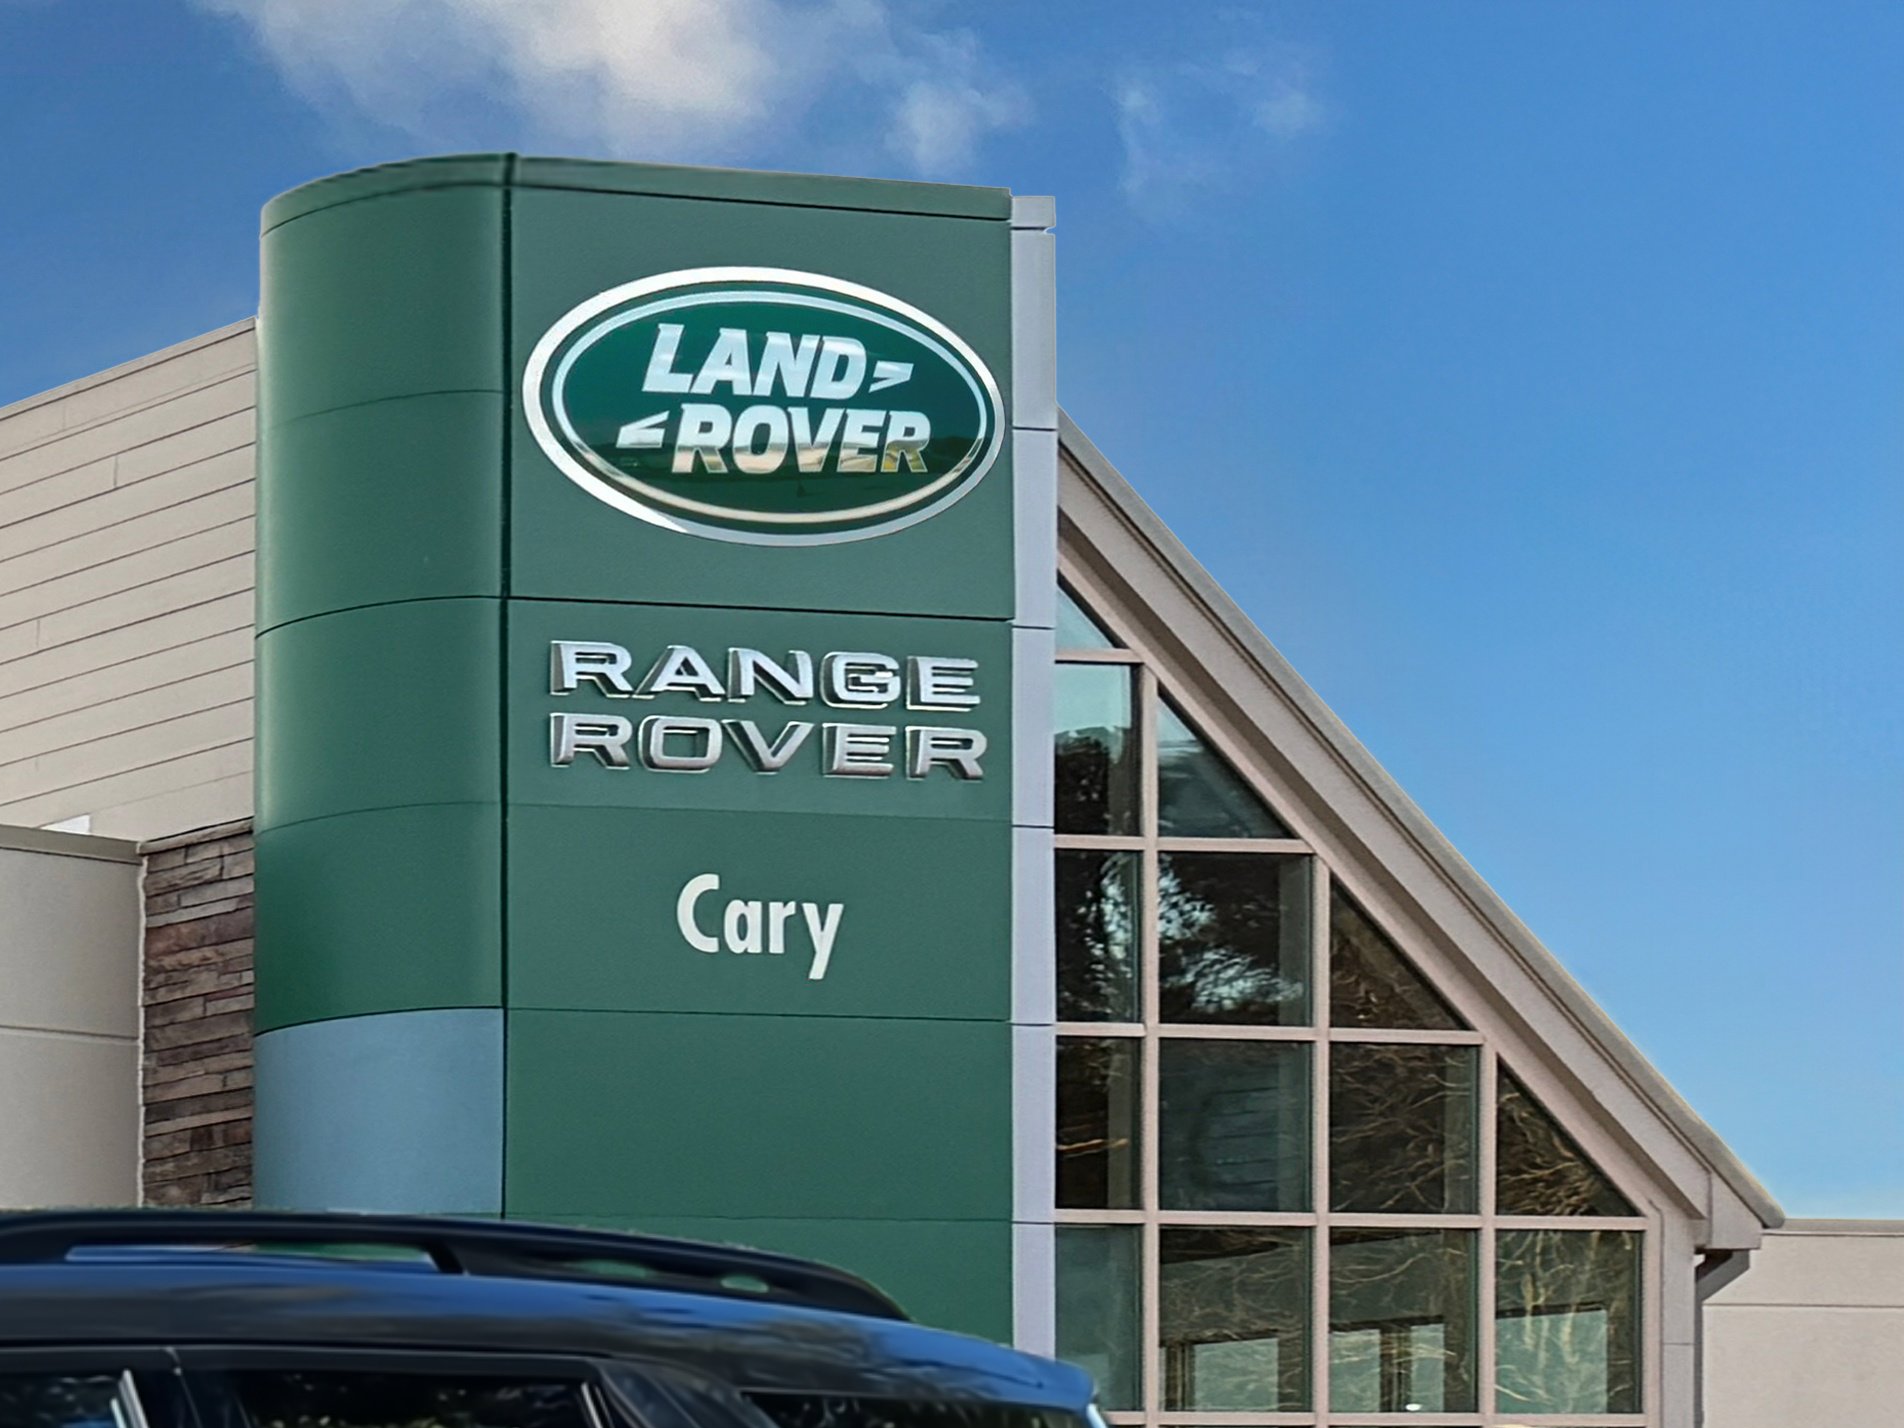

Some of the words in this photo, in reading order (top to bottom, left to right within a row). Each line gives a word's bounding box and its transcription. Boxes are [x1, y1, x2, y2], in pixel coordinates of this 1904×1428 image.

[642, 323, 868, 400] LAND
[671, 403, 932, 474] ROVER
[550, 640, 982, 711] RANGE
[550, 712, 989, 781] ROVER
[677, 873, 844, 980] Cary
